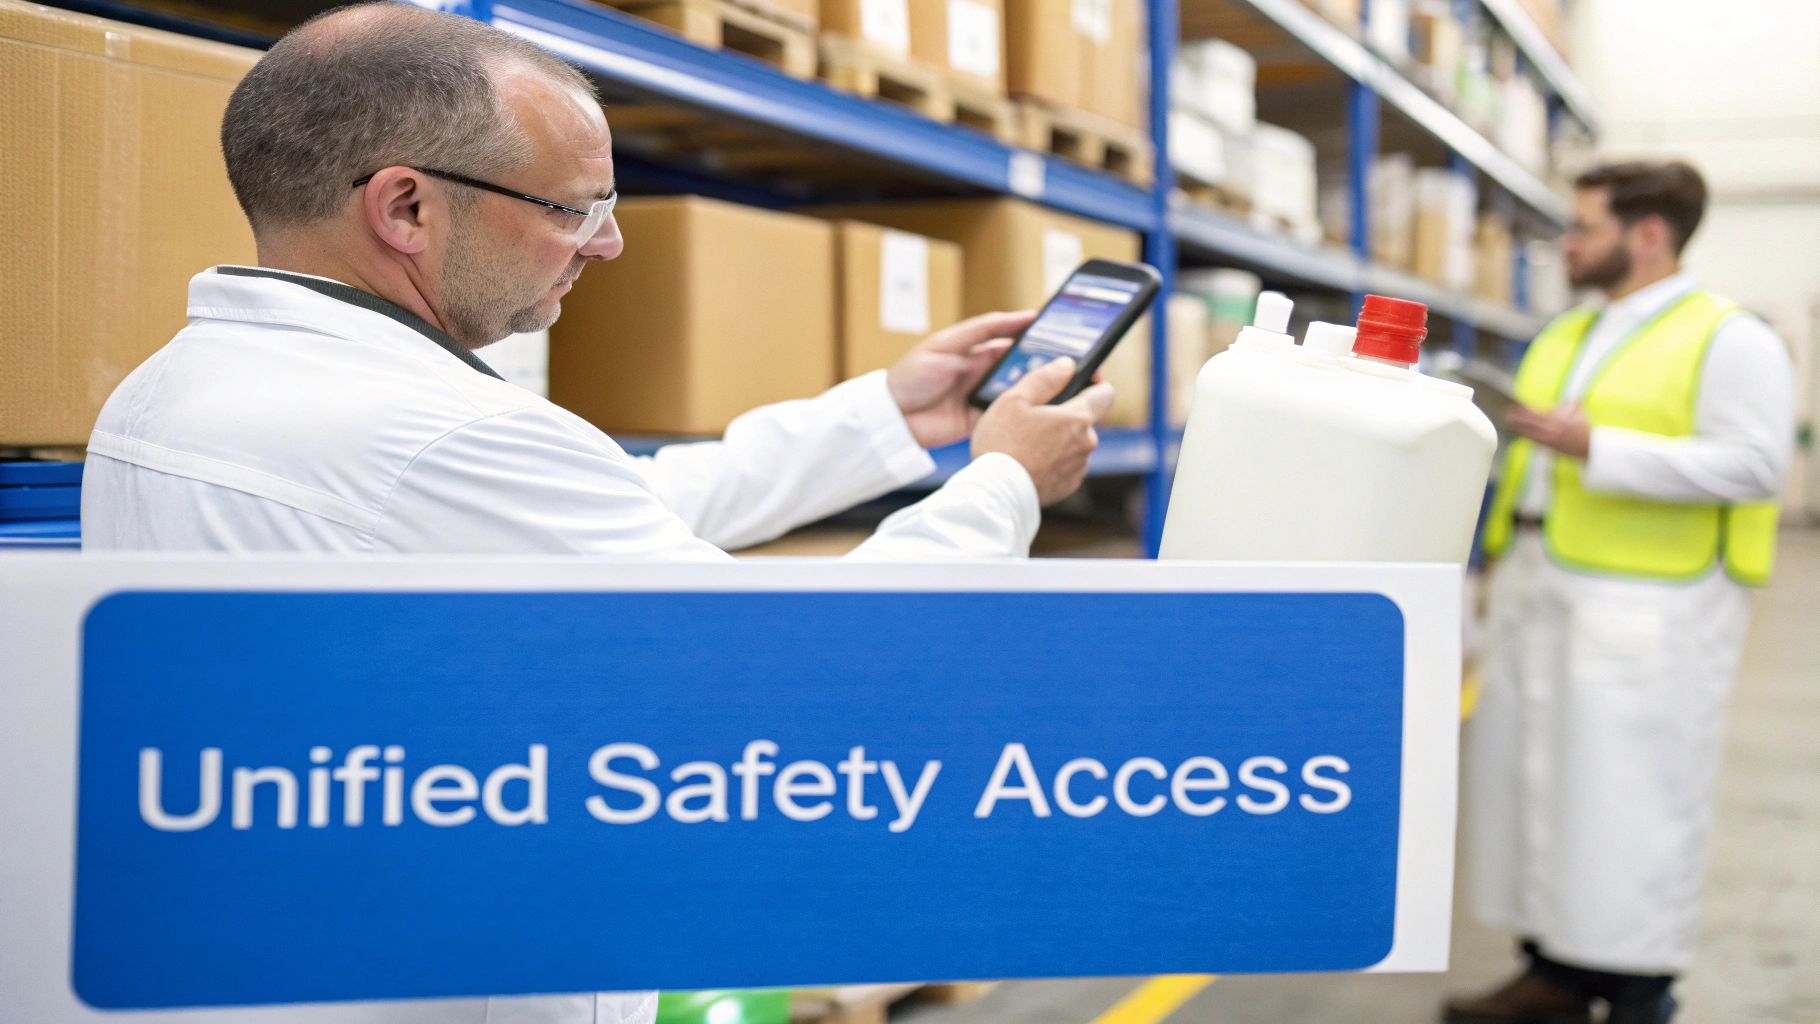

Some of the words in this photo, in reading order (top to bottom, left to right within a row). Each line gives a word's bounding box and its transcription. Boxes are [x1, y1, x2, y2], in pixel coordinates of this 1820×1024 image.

[138, 744, 549, 831] Unified
[585, 739, 942, 833] Safety
[974, 742, 1353, 818] Access
